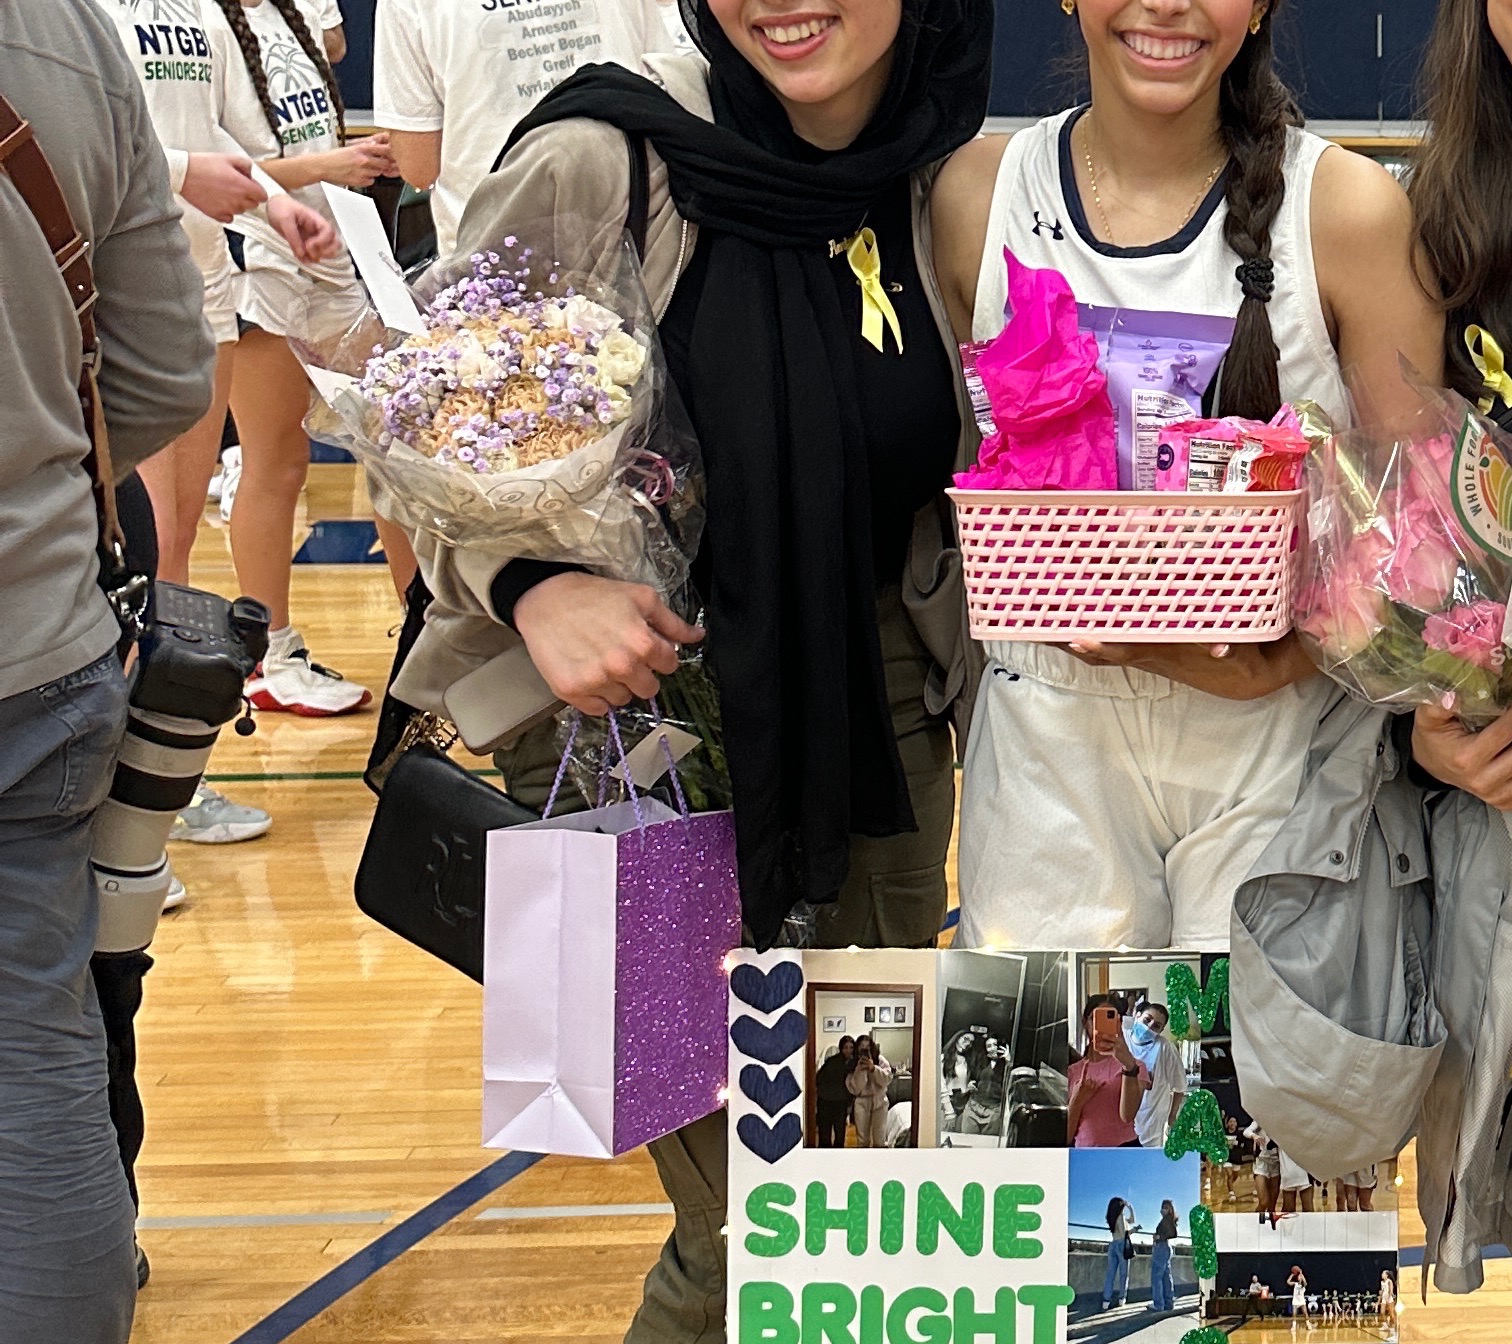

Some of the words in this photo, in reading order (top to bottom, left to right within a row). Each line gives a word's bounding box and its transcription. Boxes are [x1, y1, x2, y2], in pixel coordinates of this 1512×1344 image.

[558, 34, 601, 51] Bogan
[145, 61, 197, 82] SENIORS
[1464, 463, 1482, 517] WHOLE
[745, 1180, 1044, 1258] SHINE
